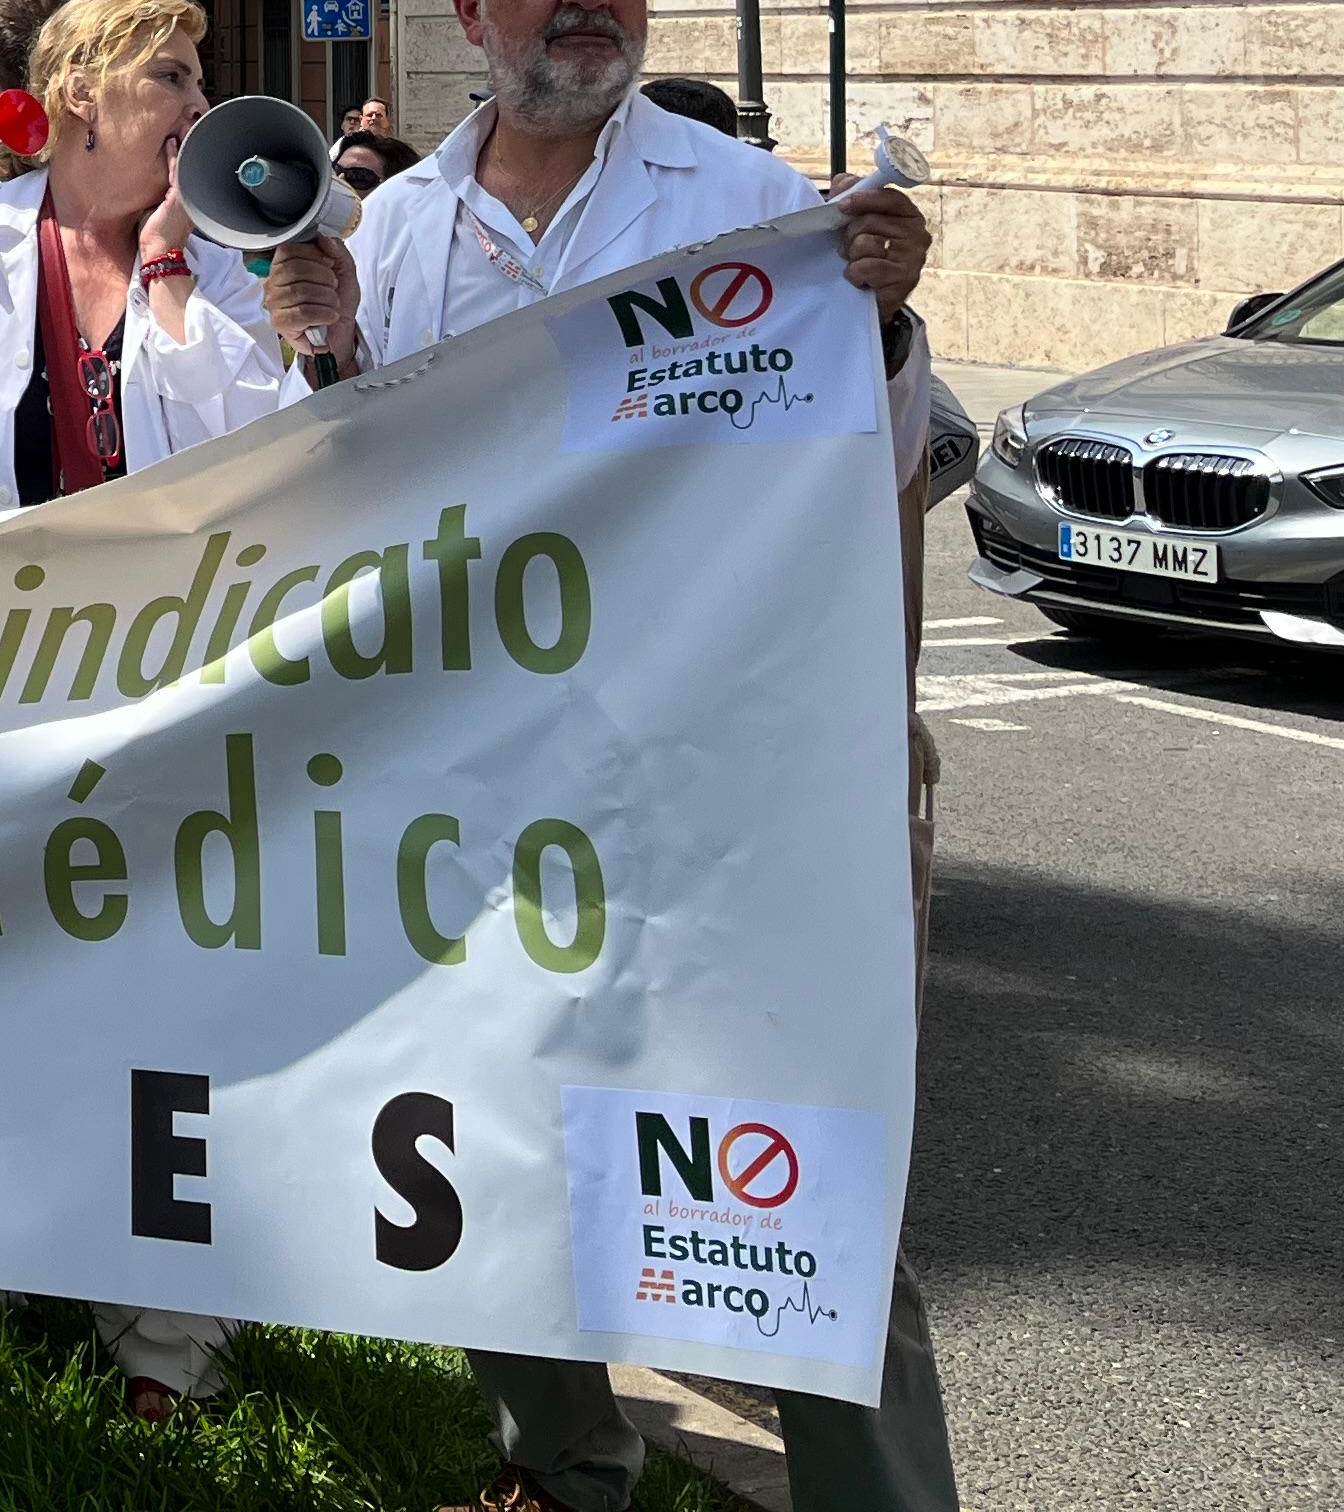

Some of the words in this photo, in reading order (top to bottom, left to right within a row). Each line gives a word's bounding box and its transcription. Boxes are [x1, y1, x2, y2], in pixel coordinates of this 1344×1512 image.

[626, 343, 794, 393] Estatuto
[628, 346, 645, 365] al
[652, 334, 733, 360] borrador
[735, 326, 757, 340] de
[1075, 531, 1142, 566] 3137
[1152, 541, 1209, 577] MMZ
[643, 1199, 660, 1216] al
[668, 1199, 754, 1227] borrador
[759, 1211, 784, 1231] de
[641, 1223, 818, 1279] Estatuto
